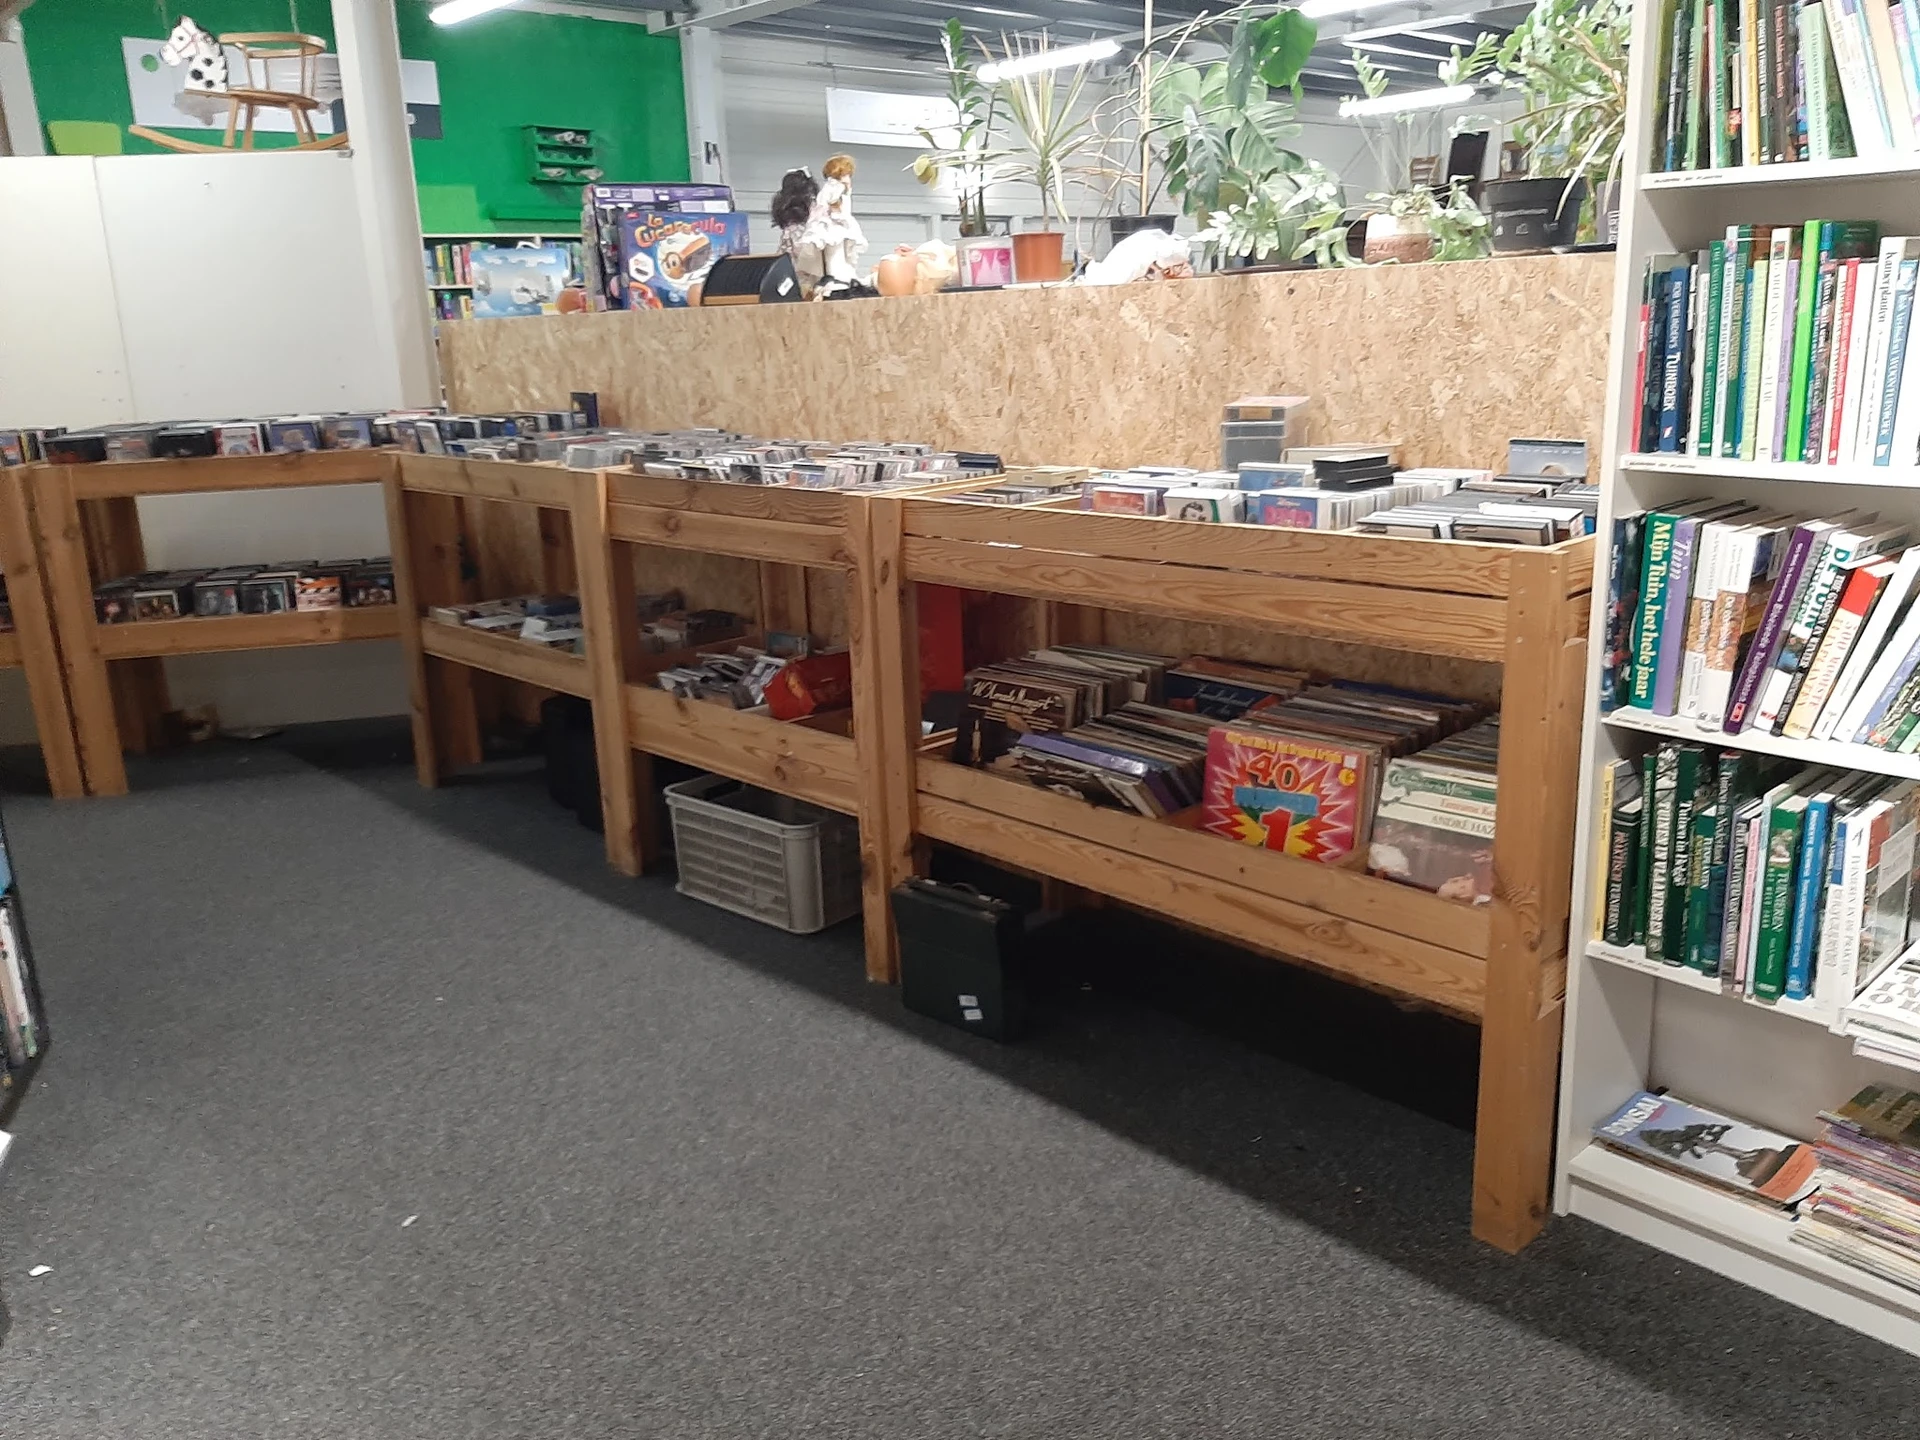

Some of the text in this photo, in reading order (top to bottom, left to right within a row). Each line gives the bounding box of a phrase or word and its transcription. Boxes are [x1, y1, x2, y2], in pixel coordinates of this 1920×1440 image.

[647, 213, 664, 228] La
[1877, 251, 1898, 324] Kamerplanten
[1664, 351, 1681, 413] TUINBOEK
[1635, 521, 1673, 699] Mijn Tuin, het hele jaar
[1246, 752, 1301, 793] 40
[1677, 799, 1693, 840] Tuinen
[1650, 801, 1671, 936] TUINEN IN VLAANDEREN
